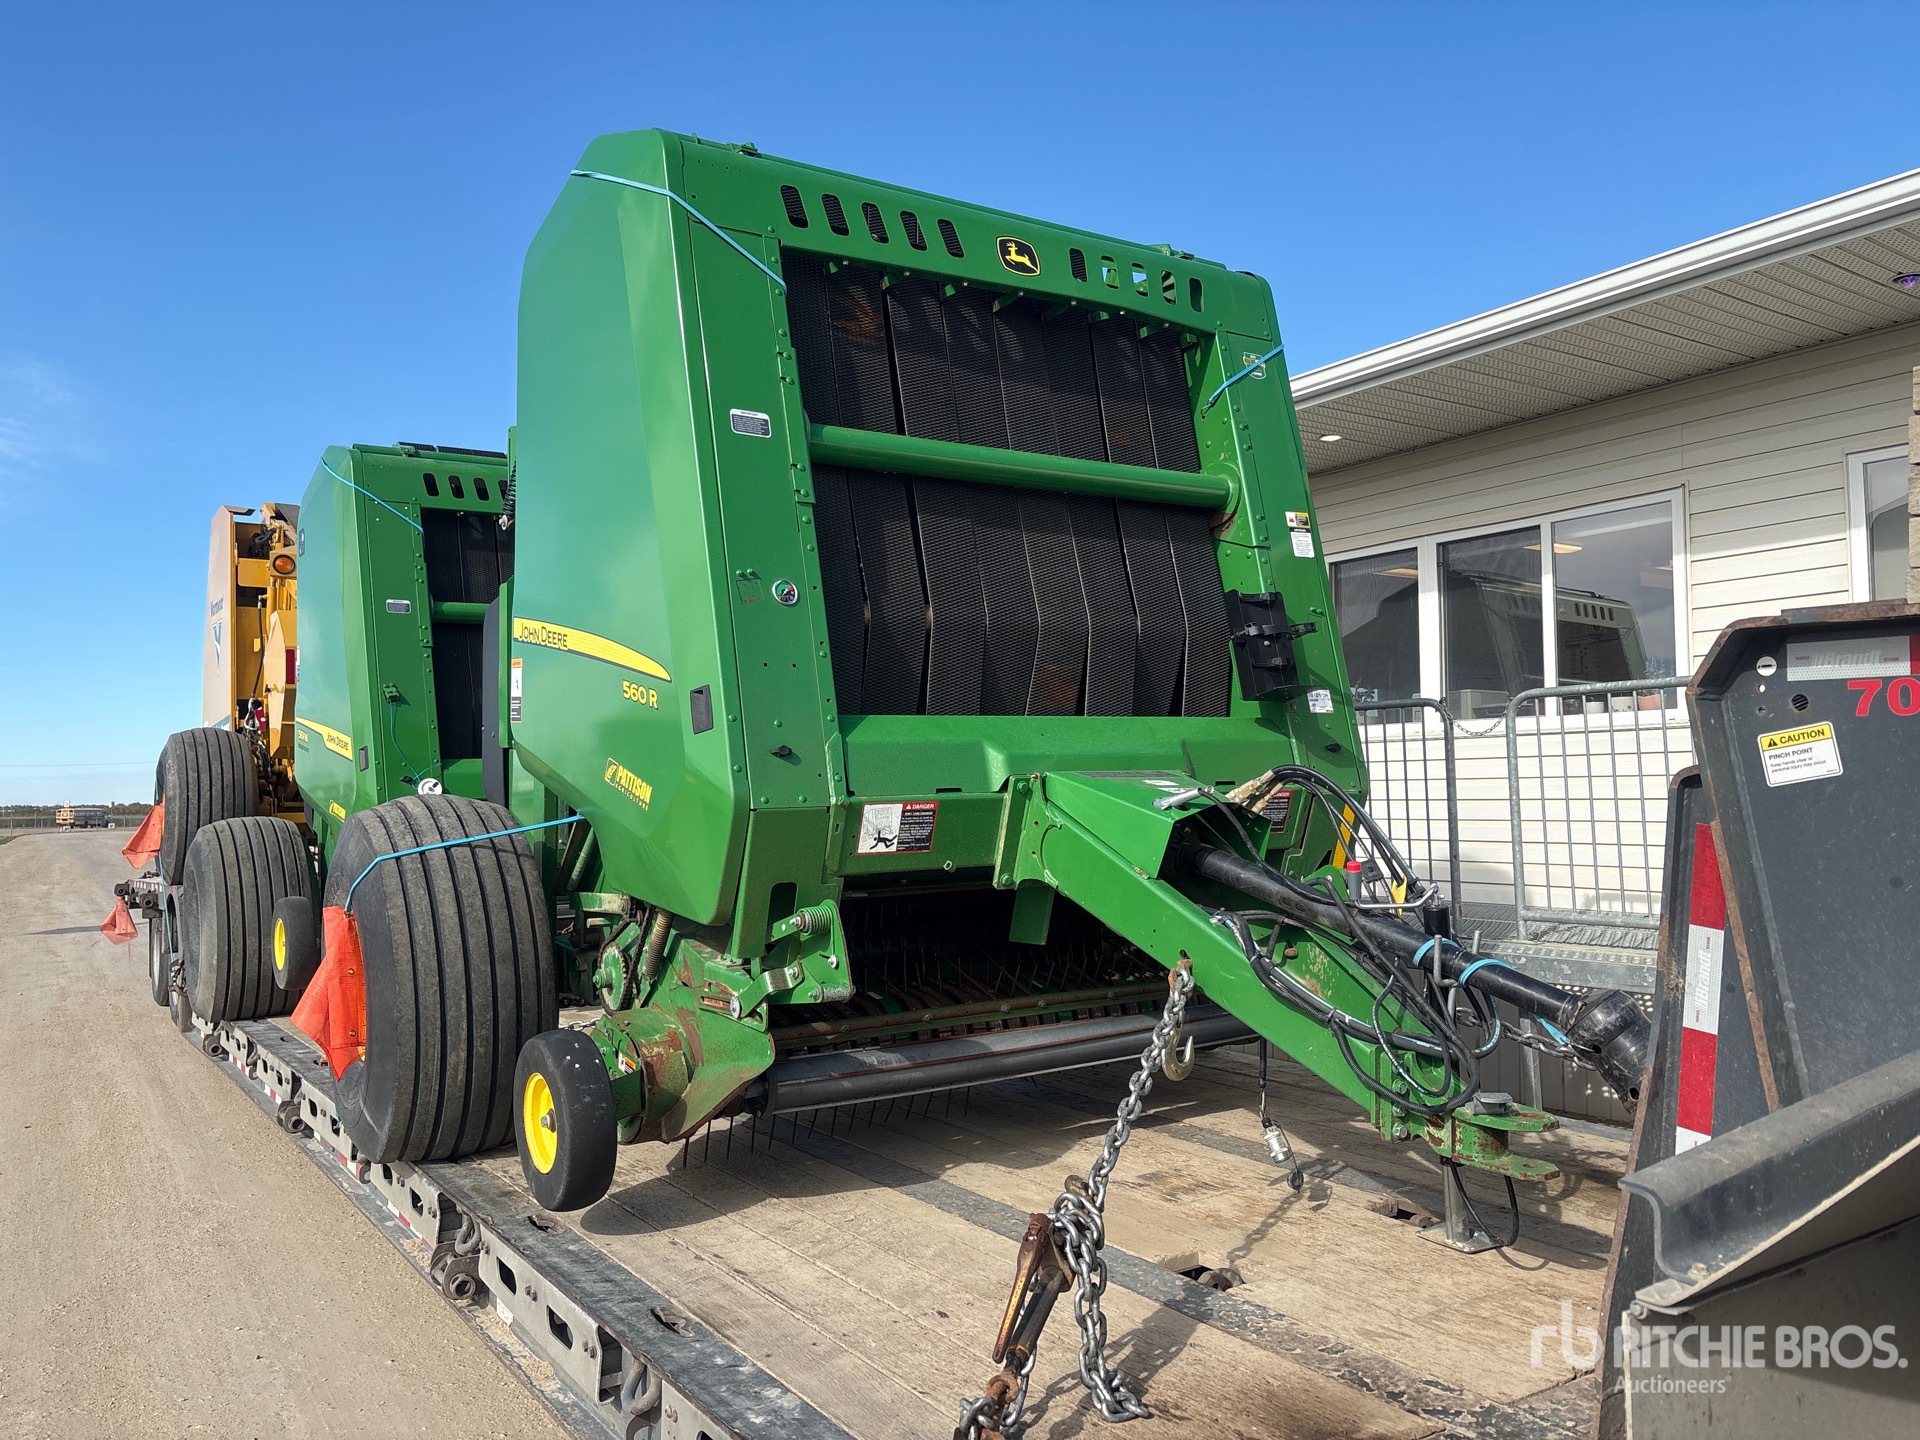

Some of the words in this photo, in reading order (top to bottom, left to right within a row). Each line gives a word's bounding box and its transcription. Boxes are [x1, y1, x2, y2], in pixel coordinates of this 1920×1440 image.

[519, 622, 540, 642] JOHN
[541, 625, 568, 648] DEERE
[1823, 649, 1882, 666] Brandt
[622, 679, 648, 706] 560
[649, 688, 659, 710] R
[336, 735, 349, 751] DEERE
[1779, 728, 1825, 744] CAUTION
[1768, 751, 1791, 761] PINCH
[1791, 747, 1814, 757] POINT
[616, 765, 653, 804] PATTISON
[1695, 949, 1711, 1000] Brandt
